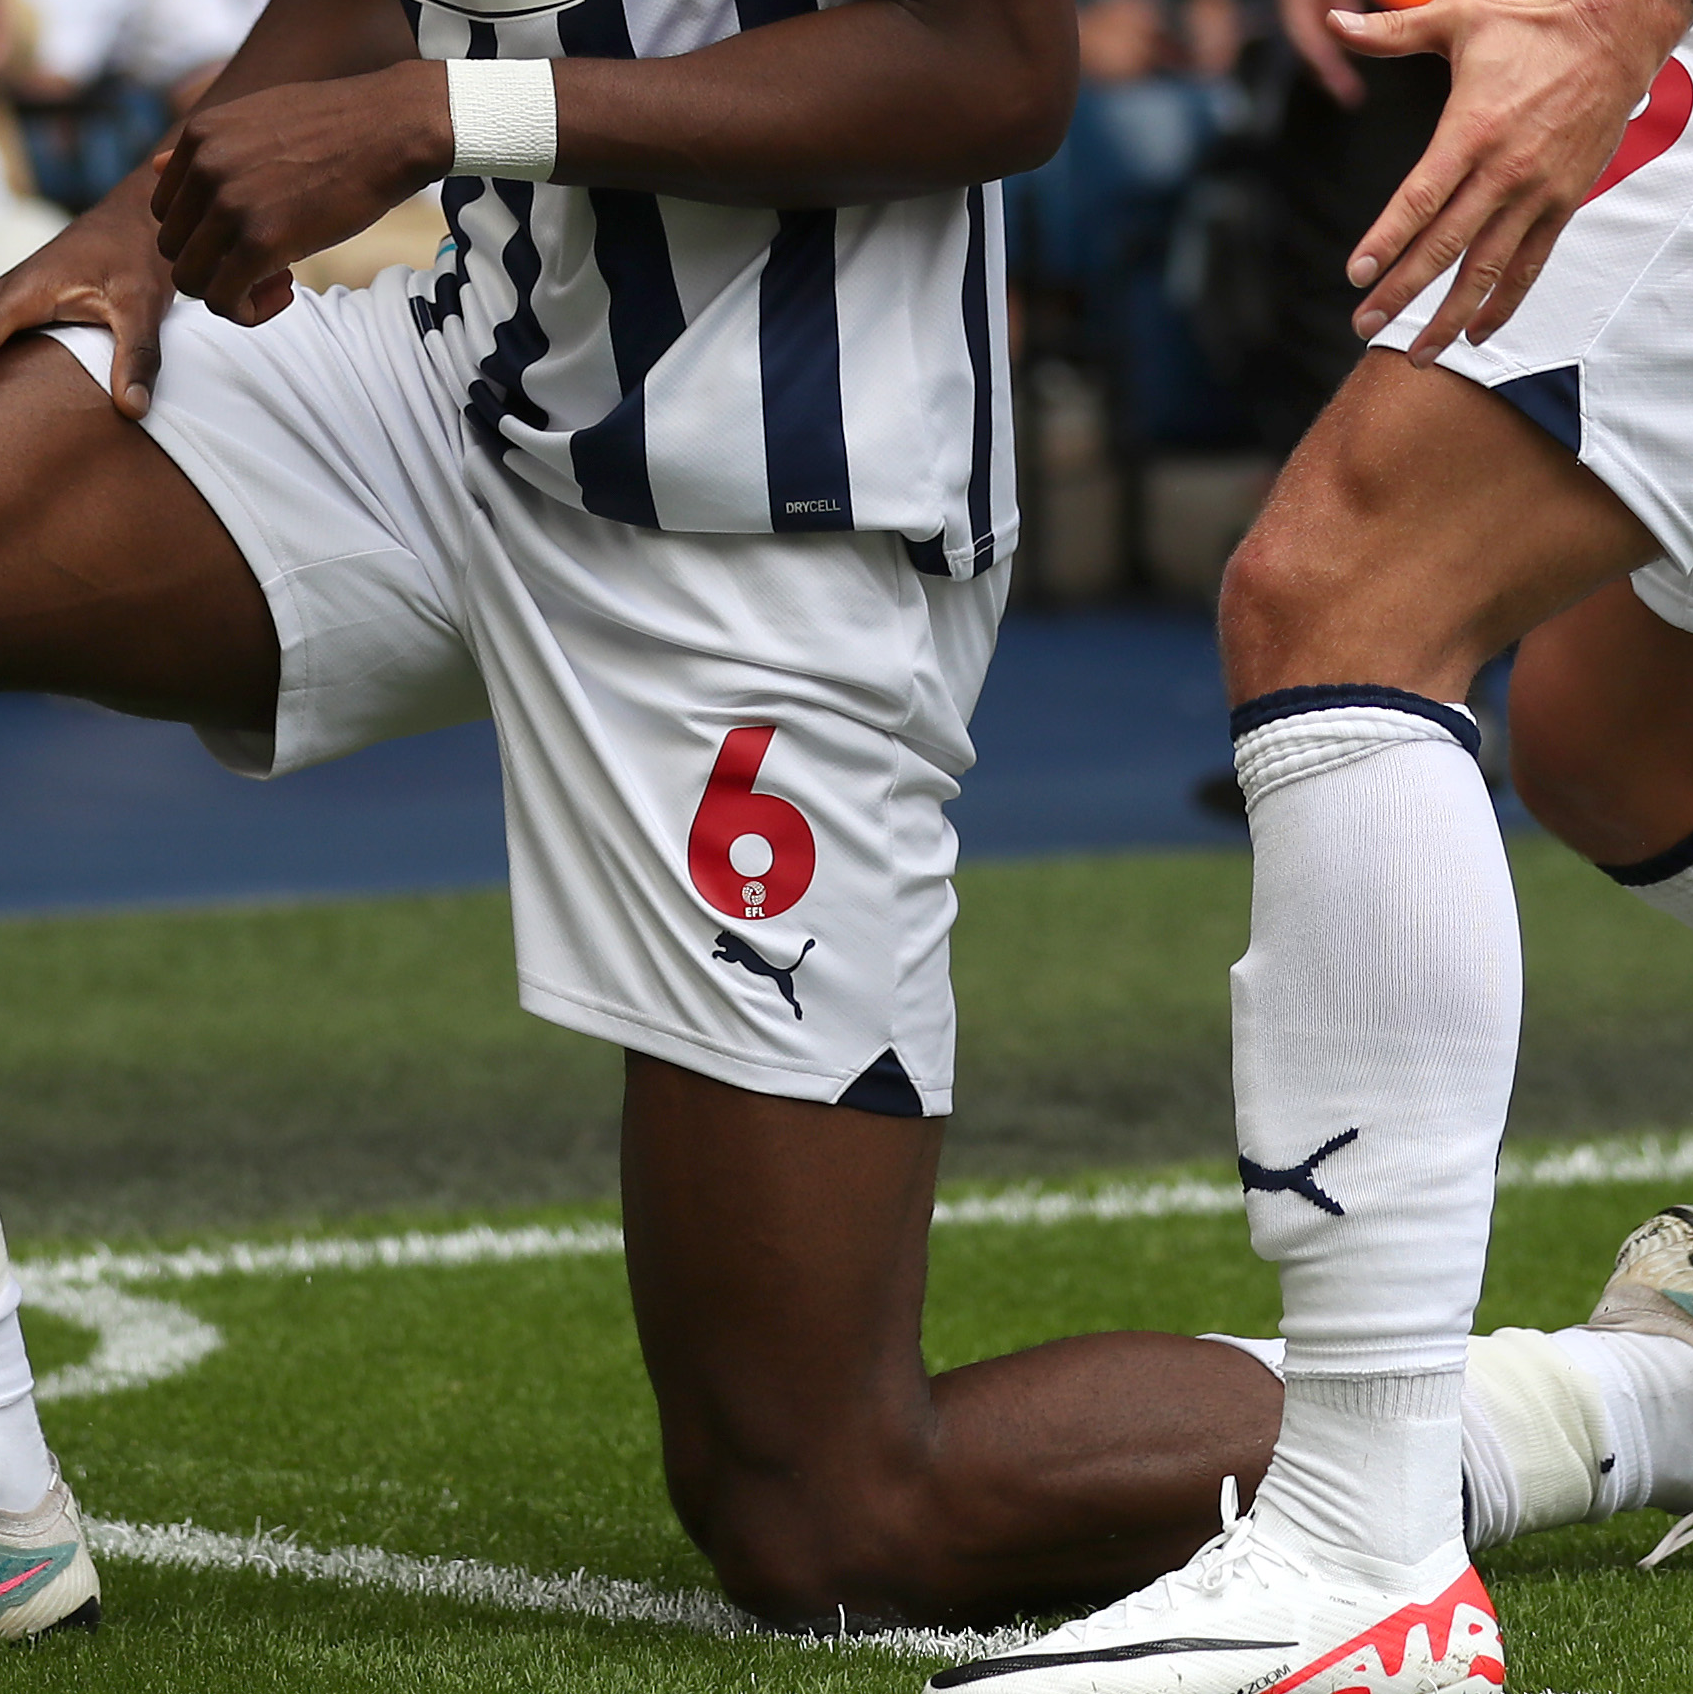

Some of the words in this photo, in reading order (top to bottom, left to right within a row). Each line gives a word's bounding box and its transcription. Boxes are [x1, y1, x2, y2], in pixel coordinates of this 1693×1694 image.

[786, 499, 841, 514] DRYCELL
[688, 725, 816, 920] 6
[744, 906, 766, 918] EFL
